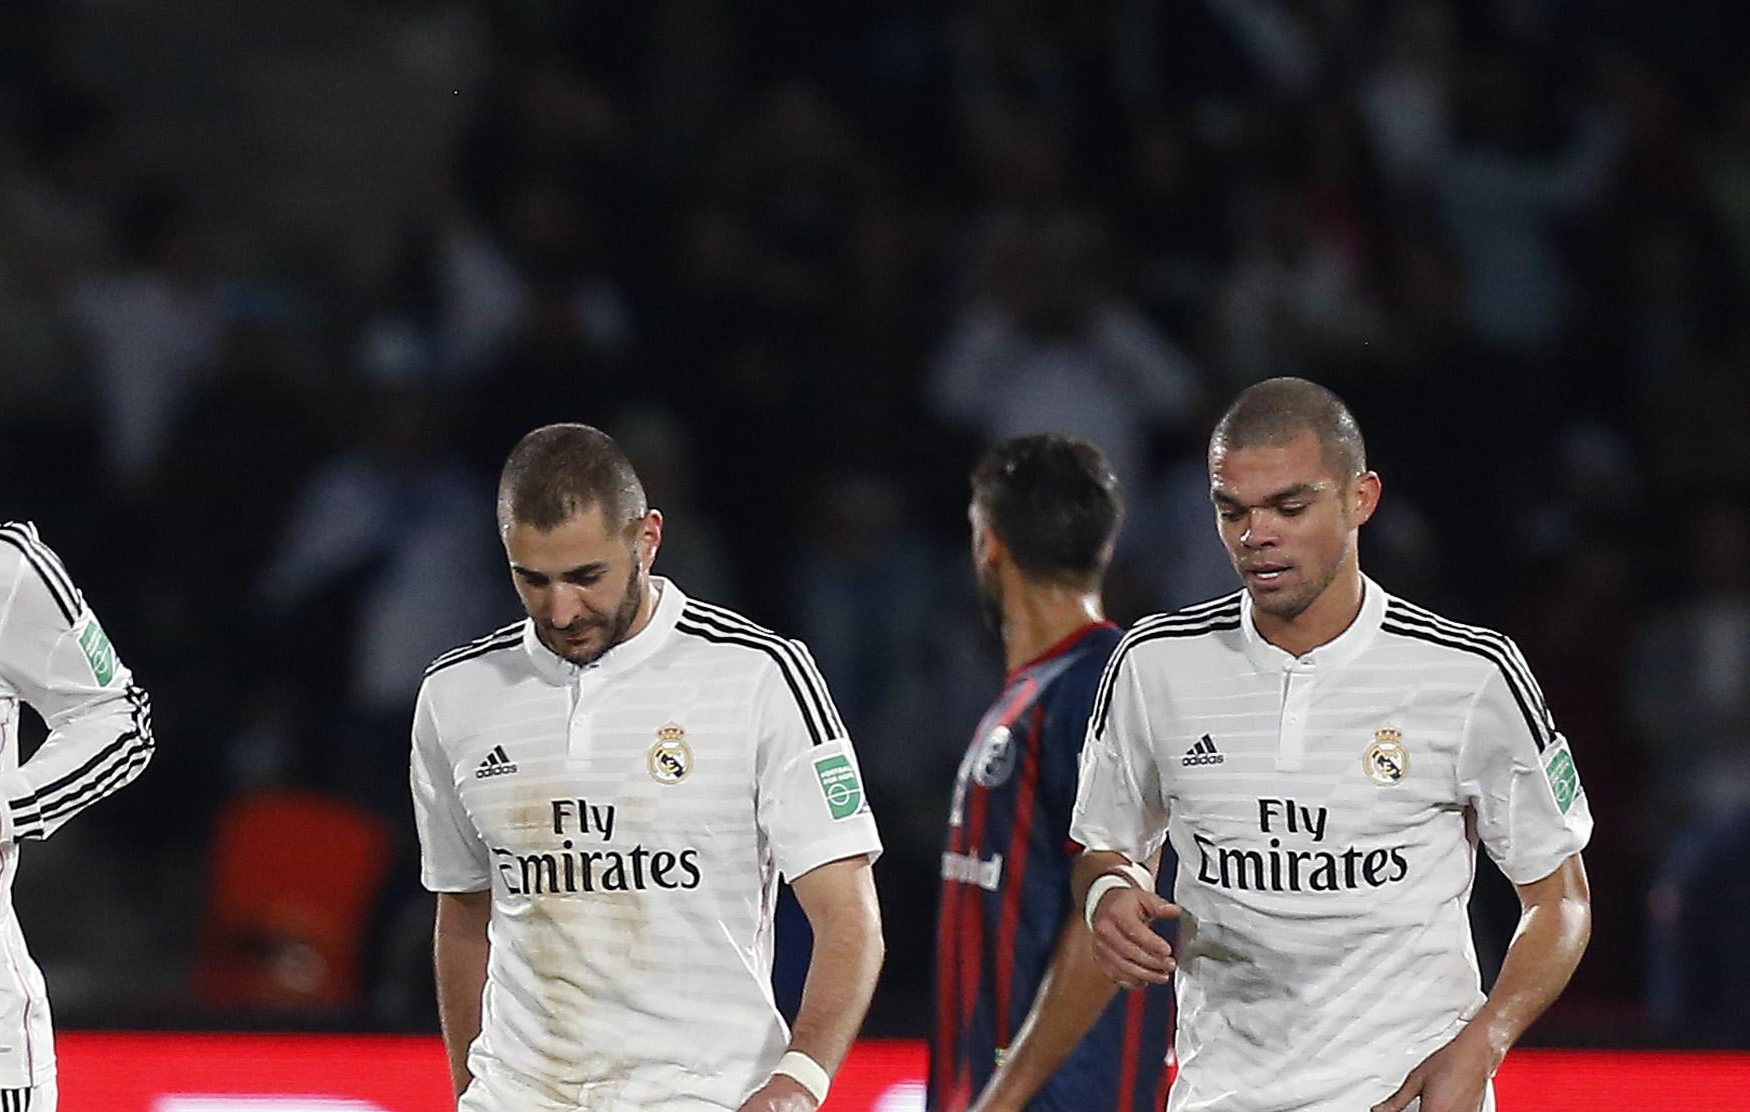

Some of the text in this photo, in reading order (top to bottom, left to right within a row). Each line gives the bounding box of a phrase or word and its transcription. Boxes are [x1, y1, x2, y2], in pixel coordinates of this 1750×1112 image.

[476, 764, 517, 778] adidas
[1182, 754, 1224, 767] adidas
[552, 799, 615, 841] Fly
[1258, 799, 1327, 841] Fly
[492, 839, 700, 894] Emirates
[1192, 833, 1408, 891] Emirates
